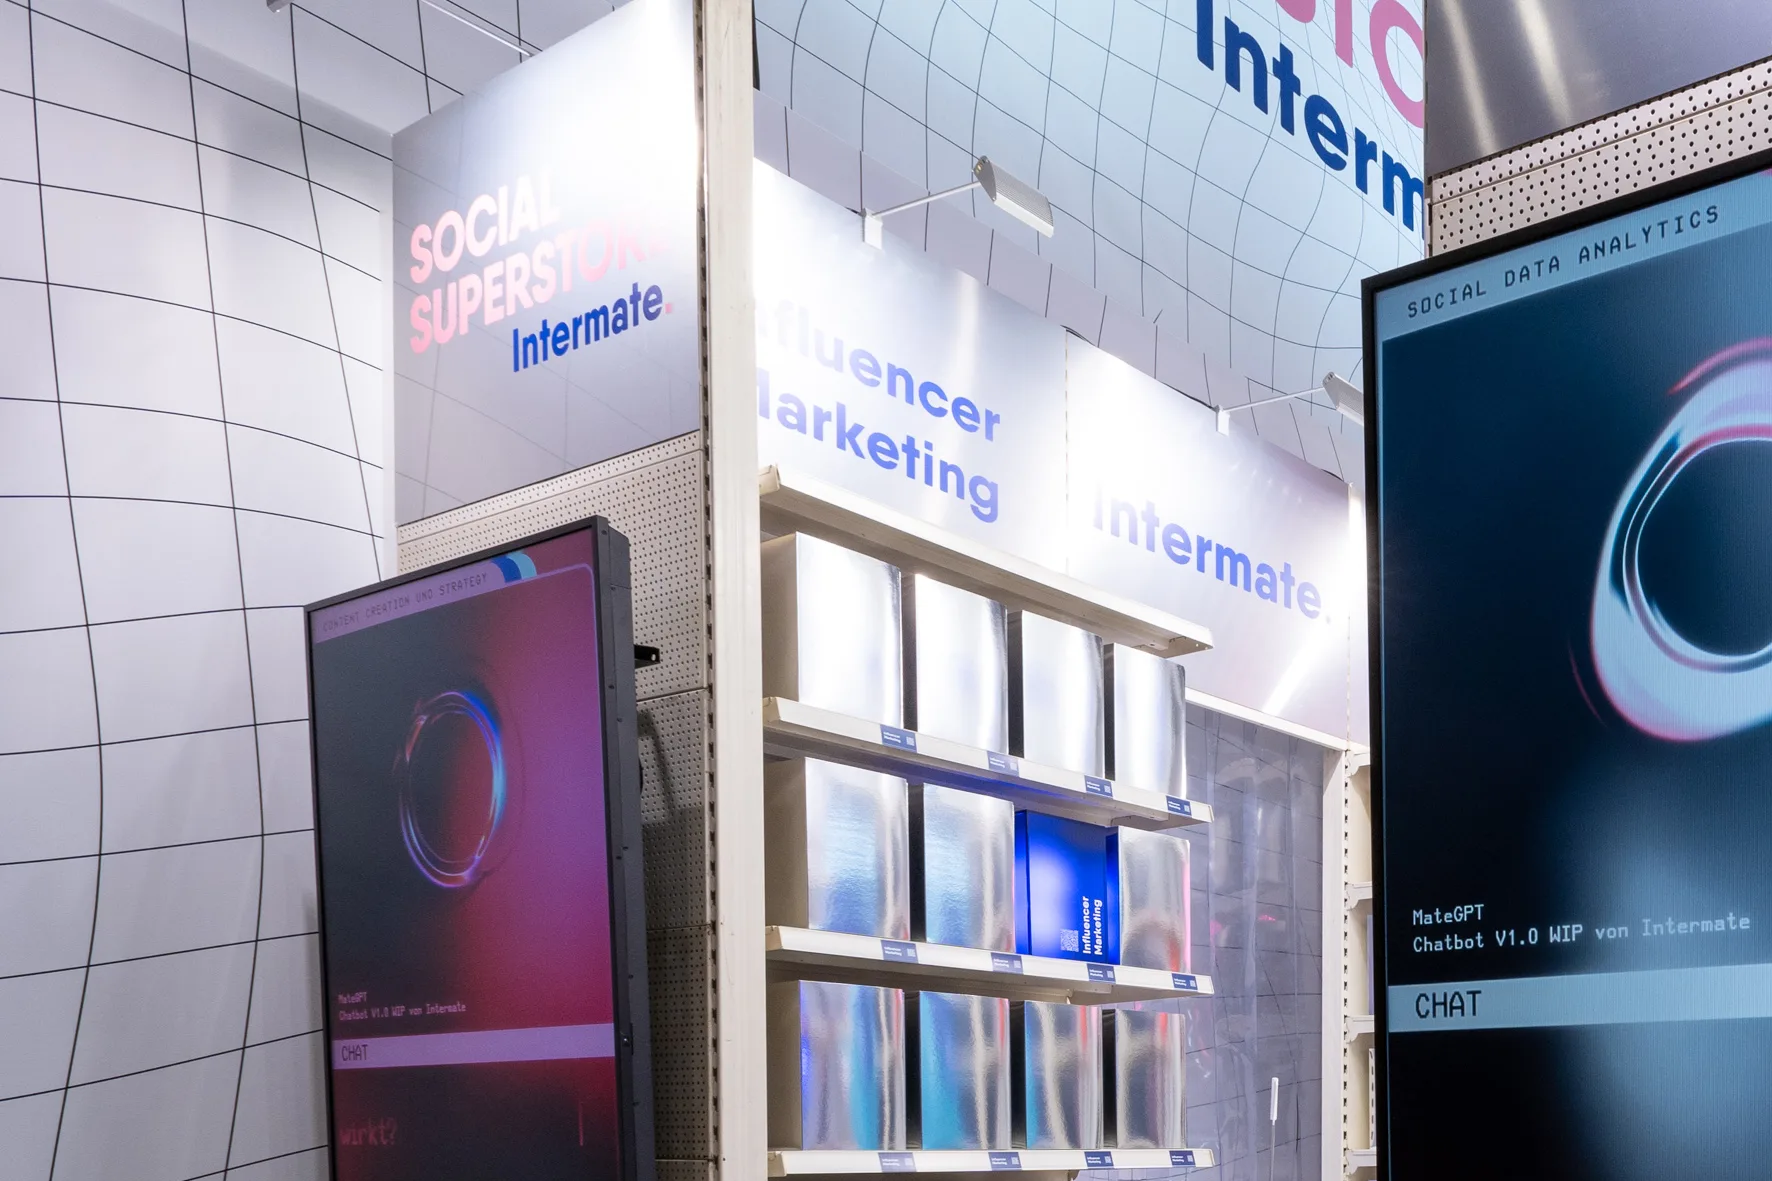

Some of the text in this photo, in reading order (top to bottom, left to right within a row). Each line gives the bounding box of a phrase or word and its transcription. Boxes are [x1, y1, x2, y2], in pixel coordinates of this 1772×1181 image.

[409, 167, 561, 284] SOCIAL
[1407, 205, 1719, 318] SOCIAL DATA ANALYTICS
[512, 282, 673, 373] Intermate.
[1082, 896, 1091, 954] Influencer
[1093, 899, 1103, 955] Marketing
[1412, 904, 1485, 926] MateGPT
[1413, 912, 1751, 952] Chatbot V1.0 WIP von Intermate
[1415, 990, 1482, 1019] CHAT
[341, 1044, 368, 1061] CHAT
